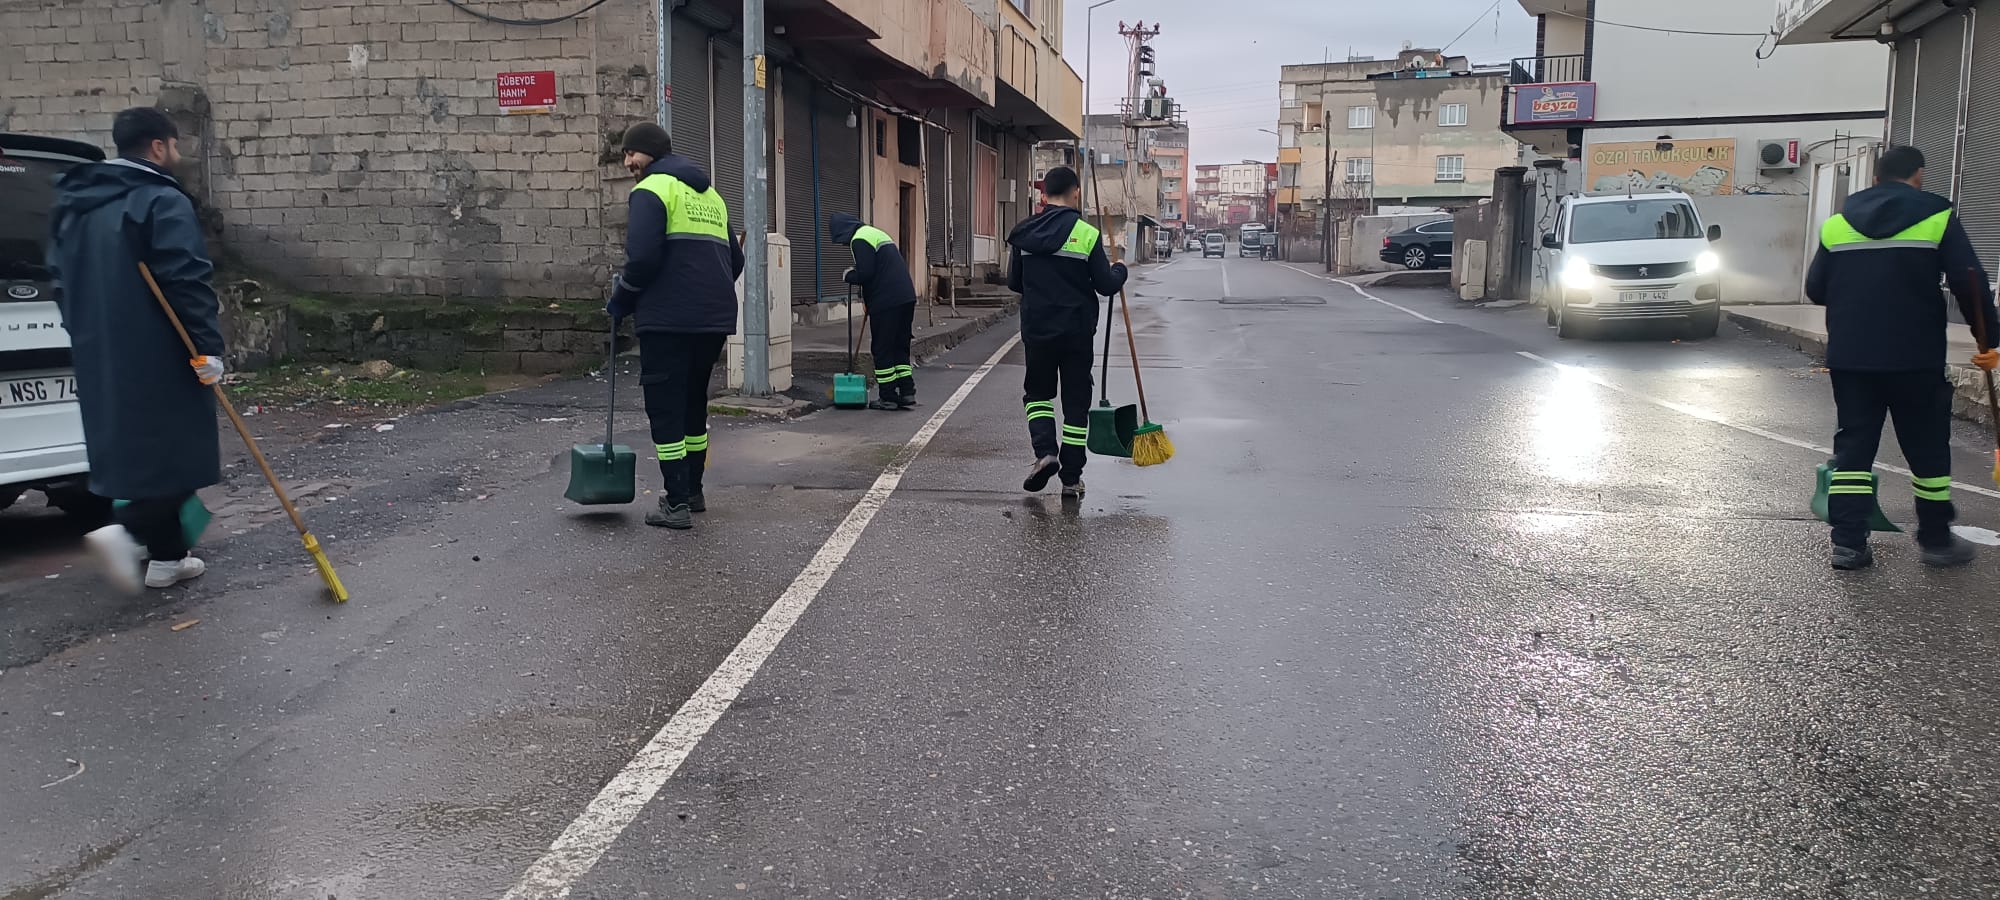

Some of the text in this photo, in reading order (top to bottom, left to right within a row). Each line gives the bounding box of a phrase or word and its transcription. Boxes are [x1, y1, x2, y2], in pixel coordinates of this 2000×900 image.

[499, 75, 536, 86] ZÜBEYDE
[500, 88, 527, 98] HANIM
[1533, 100, 1577, 112] beyza
[9, 380, 48, 403] NSG
